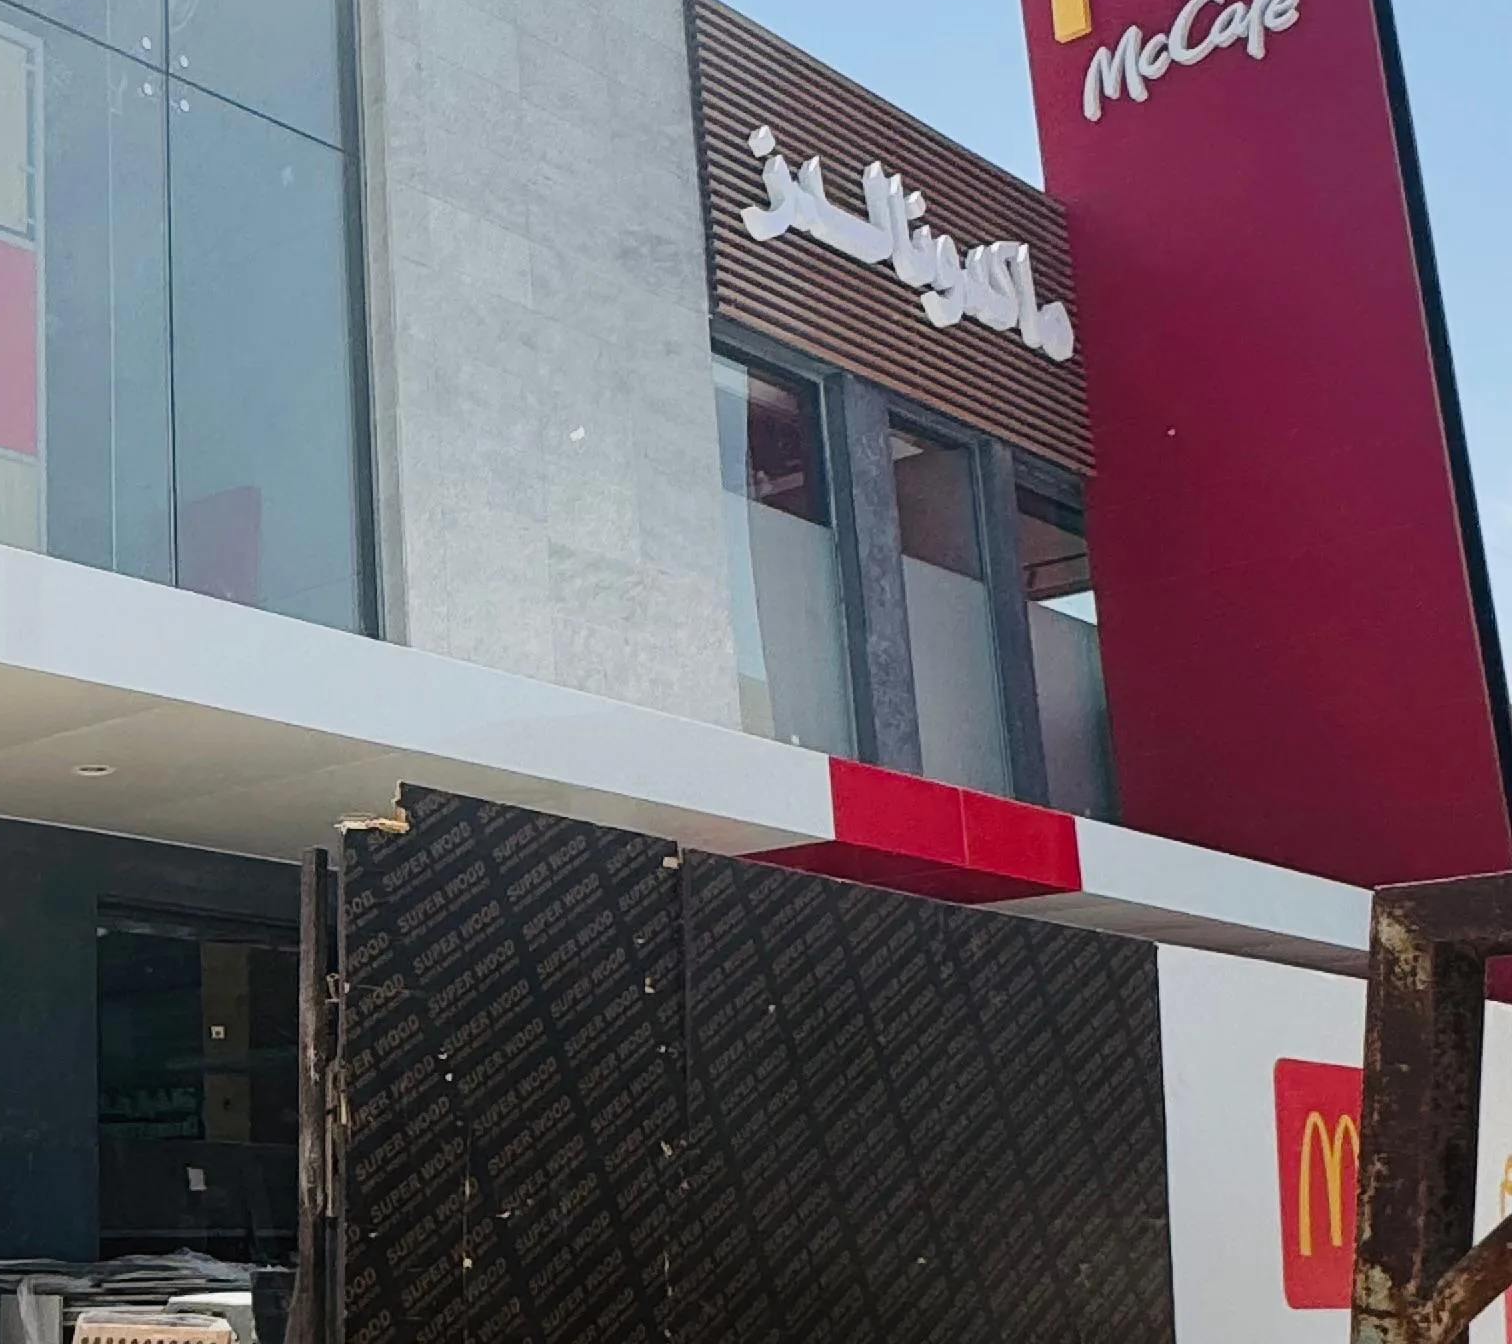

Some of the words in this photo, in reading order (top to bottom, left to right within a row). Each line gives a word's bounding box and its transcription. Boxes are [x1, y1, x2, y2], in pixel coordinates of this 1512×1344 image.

[742, 125, 1074, 361] ماكدونالدز
[382, 850, 429, 892] SUPER
[429, 820, 472, 858] WOOD
[506, 862, 549, 901] SUPER
[548, 835, 587, 869] WOOD
[345, 889, 374, 918] OOD
[397, 890, 446, 934] SUPER
[444, 860, 485, 897] WOOD
[522, 900, 563, 940] SUPER
[562, 873, 599, 907] WOOD
[413, 929, 462, 975] SUPER
[460, 900, 500, 938] WOOD
[536, 939, 578, 979] SUPER
[577, 910, 613, 945] WOOD
[359, 973, 405, 1016] WOOD
[428, 970, 475, 1018] SUPER
[474, 939, 515, 977] WOOD
[489, 979, 529, 1018] WOOD
[550, 977, 592, 1018] SUPER
[374, 1014, 419, 1057] WOOD
[457, 1050, 505, 1094] SUPER
[503, 1017, 544, 1057] WOOD
[564, 1016, 605, 1057] SUPER
[350, 1091, 390, 1131] UPER
[389, 1055, 435, 1097] WOOD
[473, 1090, 518, 1136] SUPER
[517, 1056, 557, 1096] WOOD
[591, 1090, 631, 1134] SUPER
[355, 1132, 405, 1181] SUPER
[405, 1096, 450, 1136] WOOD
[488, 1129, 533, 1176] SUPER
[531, 1096, 571, 1135] WOOD
[370, 1173, 421, 1223] SUPER
[421, 1136, 464, 1179] WOOD
[501, 1169, 545, 1212] SUPER
[546, 1134, 584, 1176] WOOD
[386, 1215, 437, 1265] SUPER
[513, 1207, 558, 1255] SUPER
[558, 1172, 597, 1215] WOOD
[346, 1267, 376, 1304] OOD
[401, 1256, 451, 1308] SUPER
[528, 1246, 571, 1296] SUPER
[572, 1210, 609, 1252] WOOD
[416, 1298, 466, 1344] SUPER
[467, 1256, 506, 1302] WOOD
[477, 1296, 520, 1342] WOOD
[541, 1285, 584, 1334] SUPER
[586, 1247, 622, 1291] WOOD
